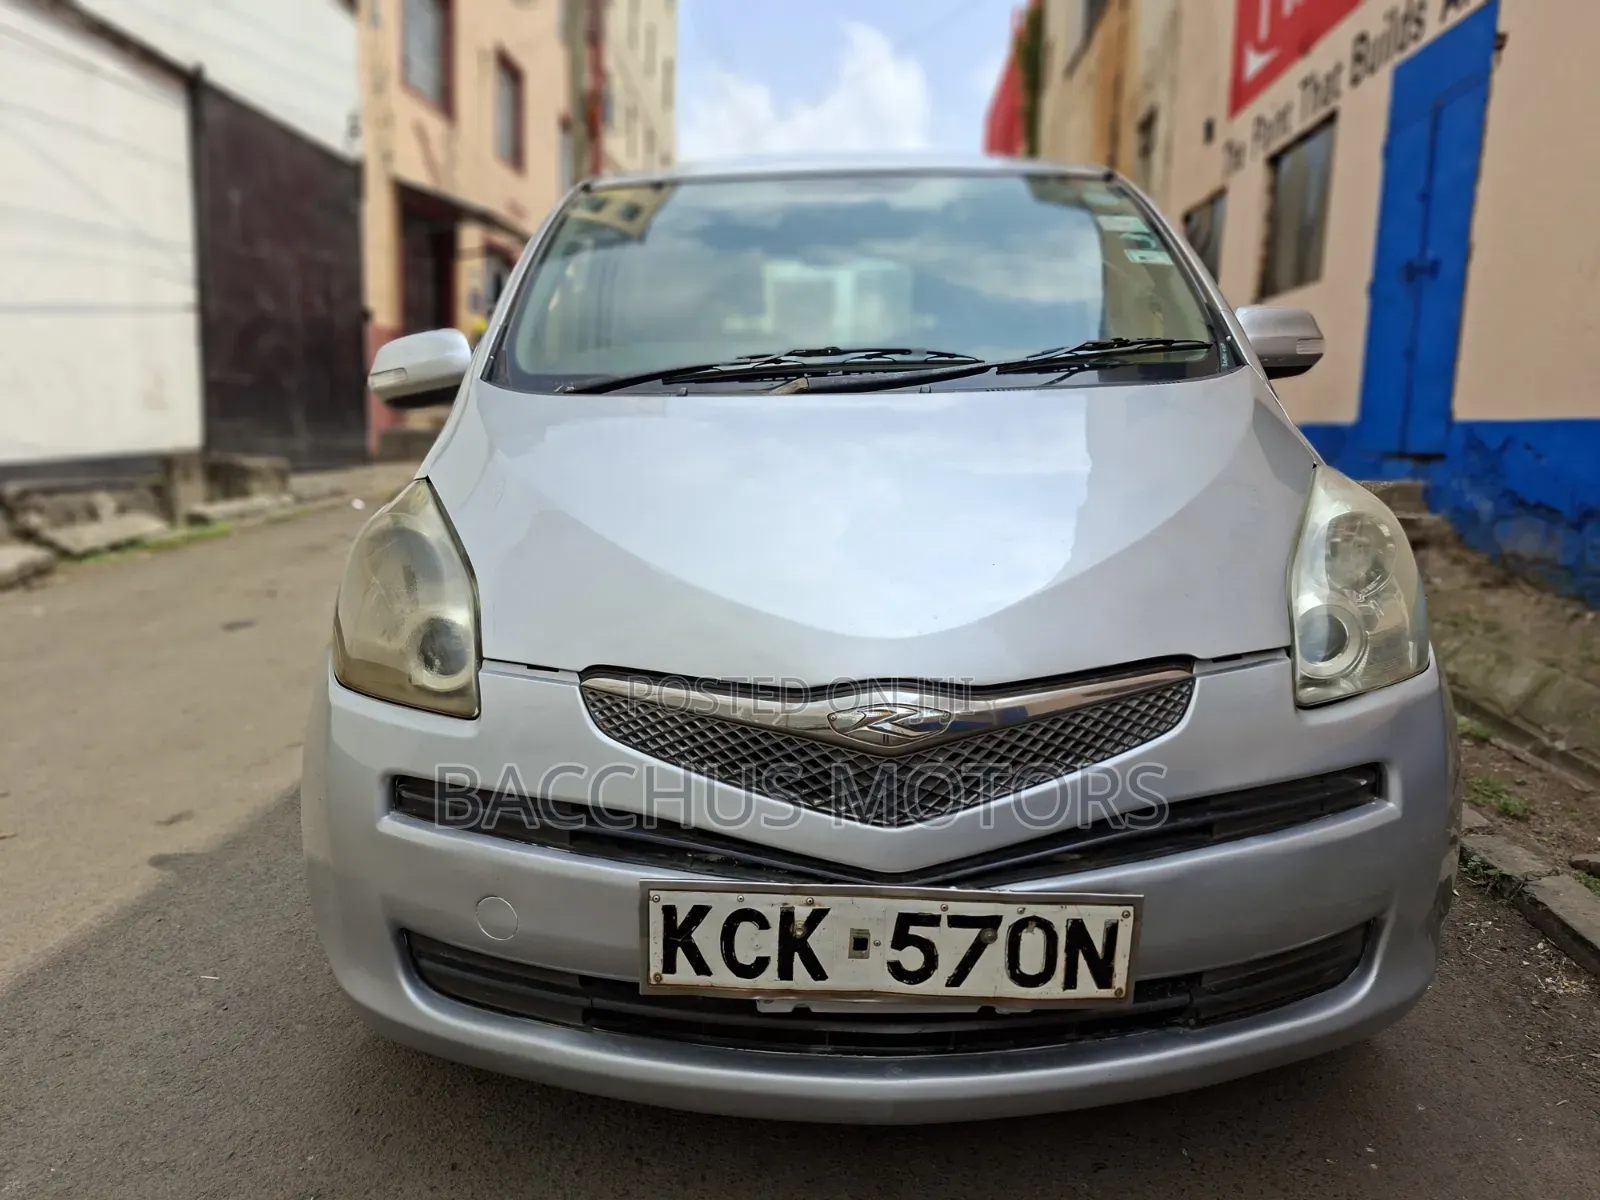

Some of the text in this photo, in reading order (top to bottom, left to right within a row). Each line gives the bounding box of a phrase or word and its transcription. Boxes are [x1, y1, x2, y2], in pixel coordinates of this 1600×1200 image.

[1350, 0, 1426, 87] Builds
[661, 904, 1120, 992] KCK 570N
